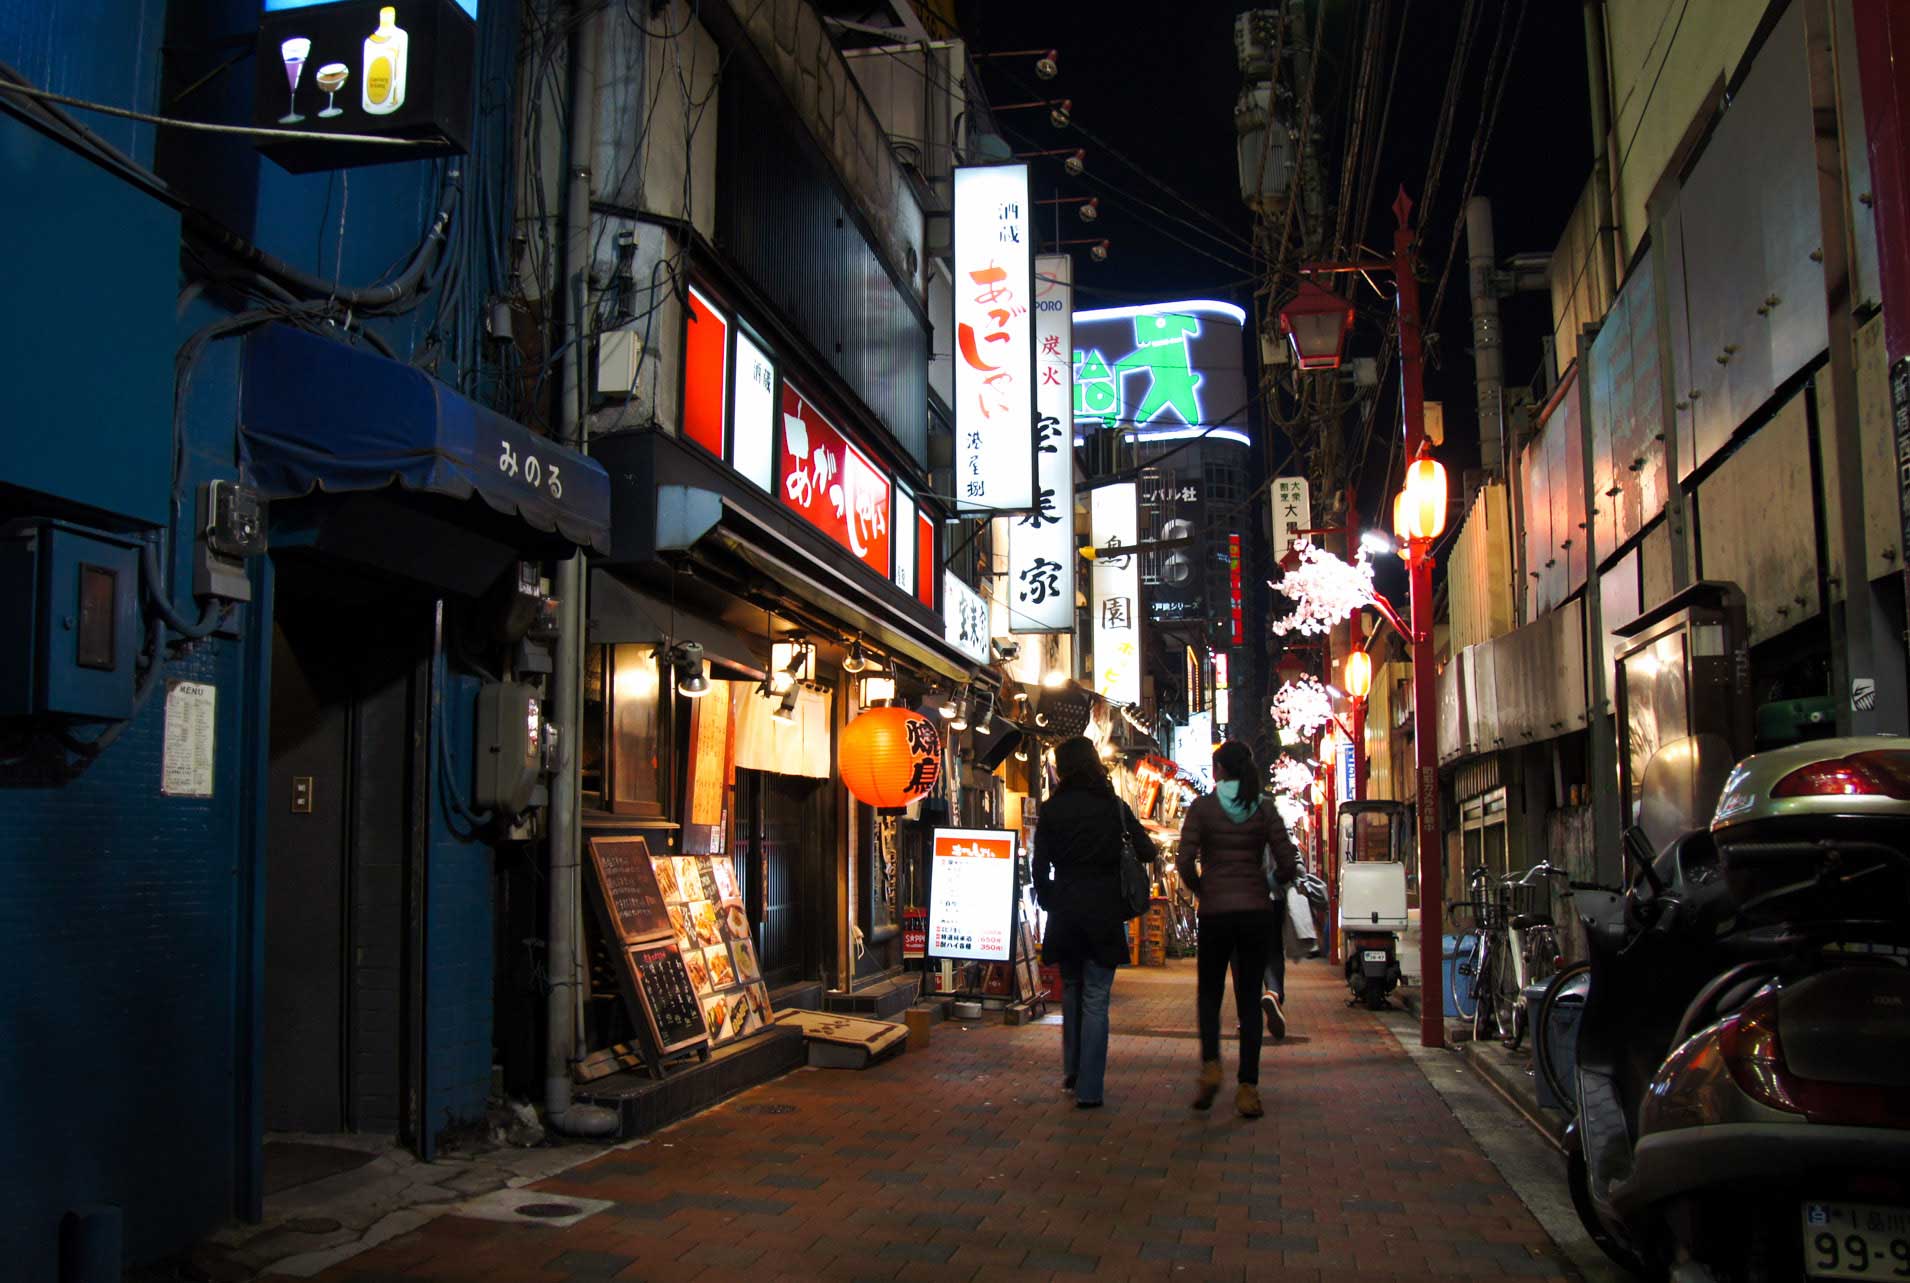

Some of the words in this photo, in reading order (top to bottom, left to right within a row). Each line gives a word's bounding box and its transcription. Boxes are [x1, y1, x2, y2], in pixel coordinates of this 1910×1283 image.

[1041, 335, 1061, 386] 炭火
[500, 440, 562, 499] みのる
[180, 686, 204, 696] MENU
